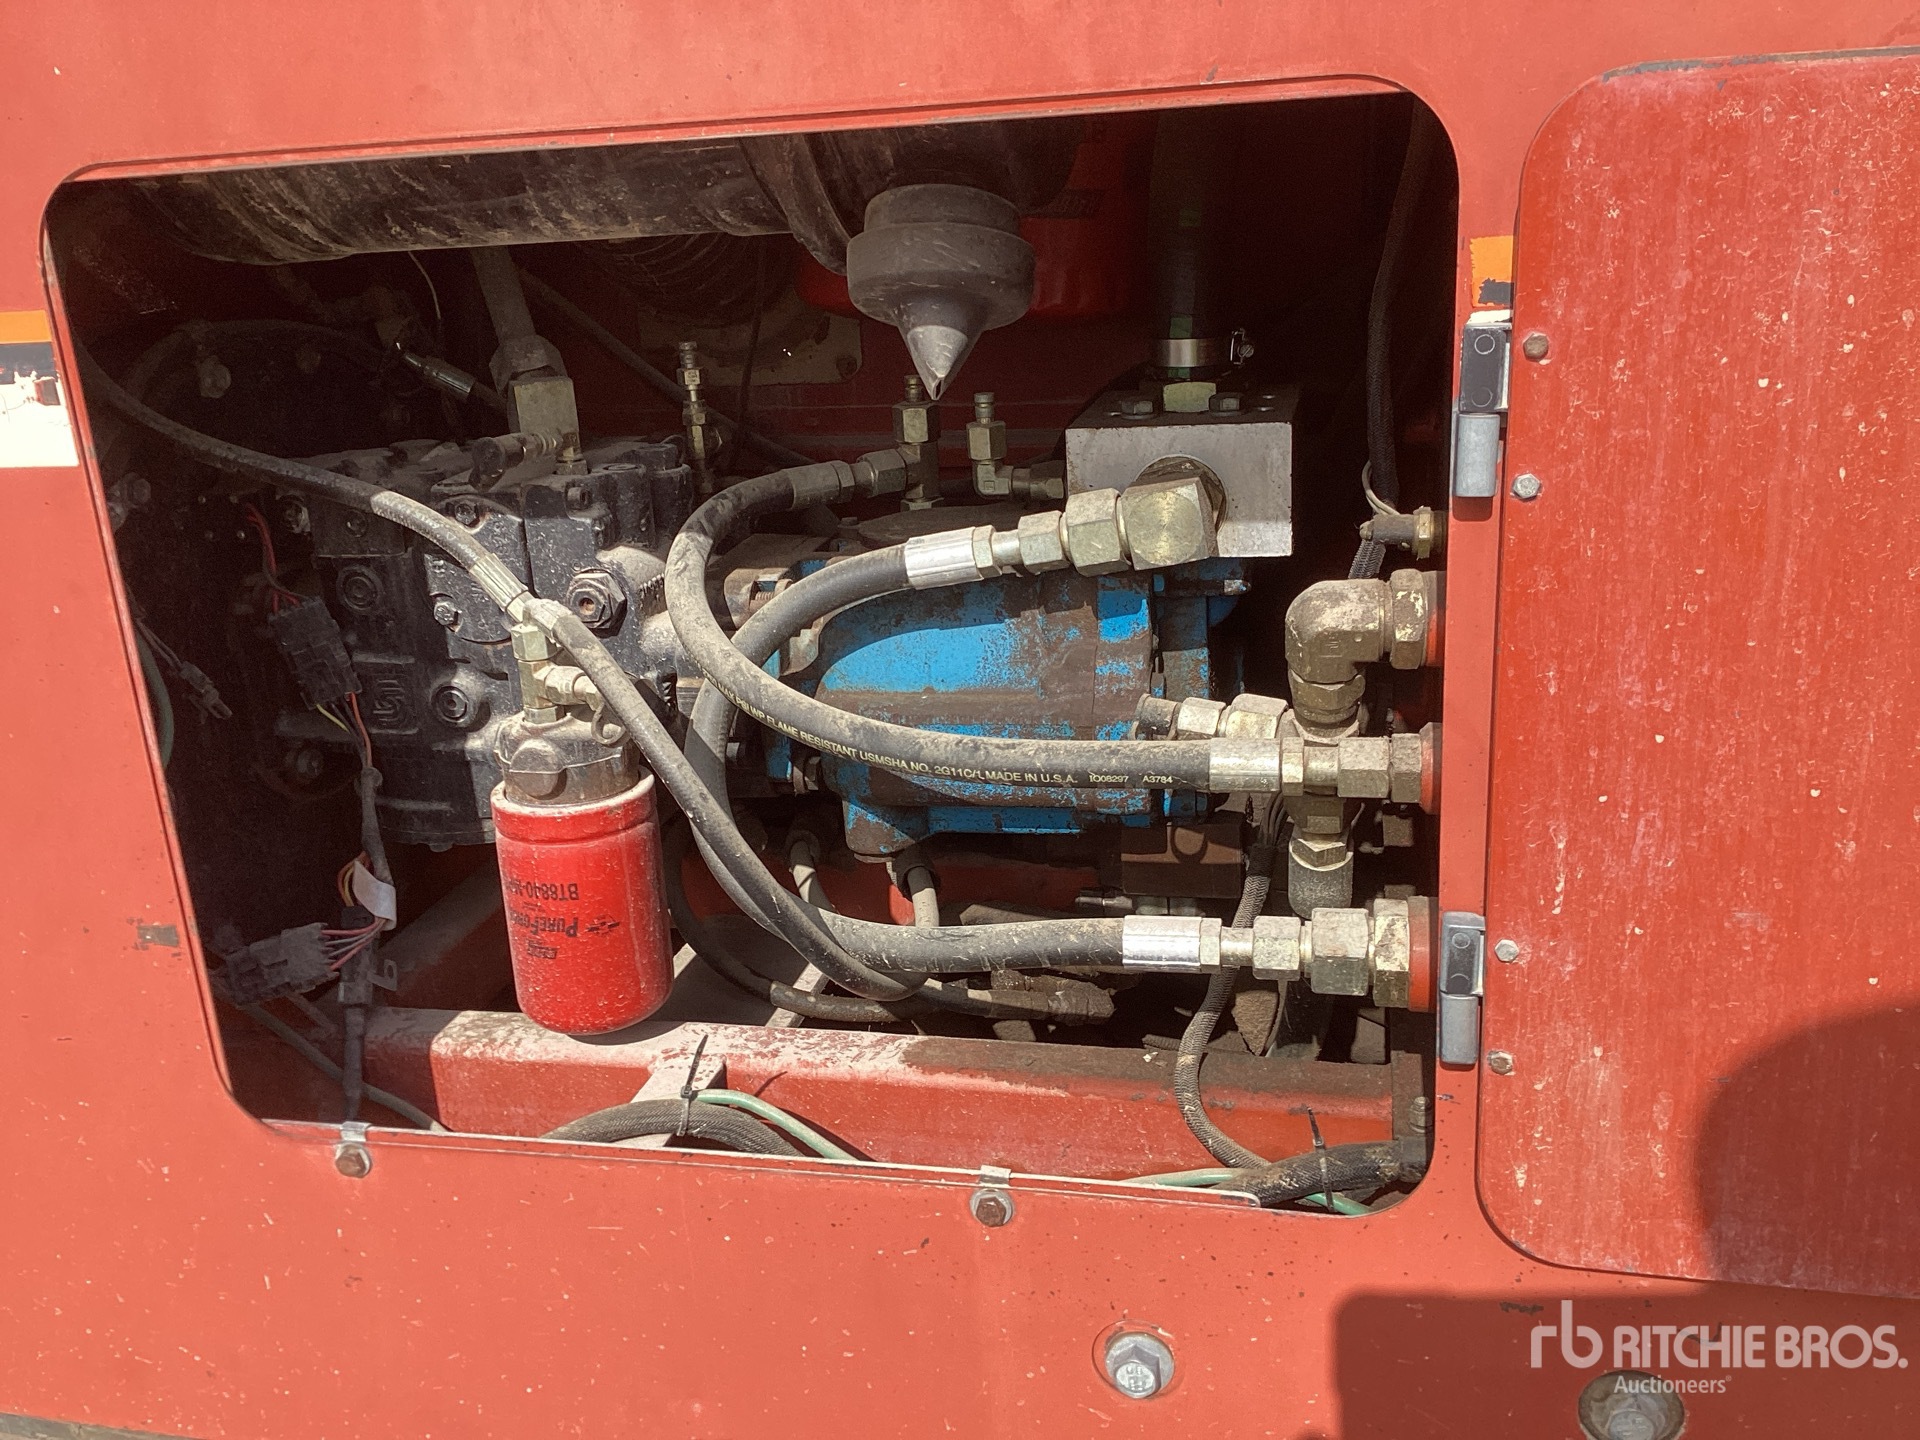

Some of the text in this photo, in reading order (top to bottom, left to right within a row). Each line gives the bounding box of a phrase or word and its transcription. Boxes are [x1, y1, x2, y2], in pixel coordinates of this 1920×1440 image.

[750, 705, 765, 719] WP
[766, 715, 799, 738] FLAME
[800, 731, 857, 758] RESISTANT
[860, 750, 908, 770] USMSHA
[910, 761, 932, 773] NO.
[985, 770, 1022, 782] MADE
[1024, 773, 1038, 782] IN
[1040, 774, 1078, 784] U.S.A.
[1142, 775, 1173, 784] A3784
